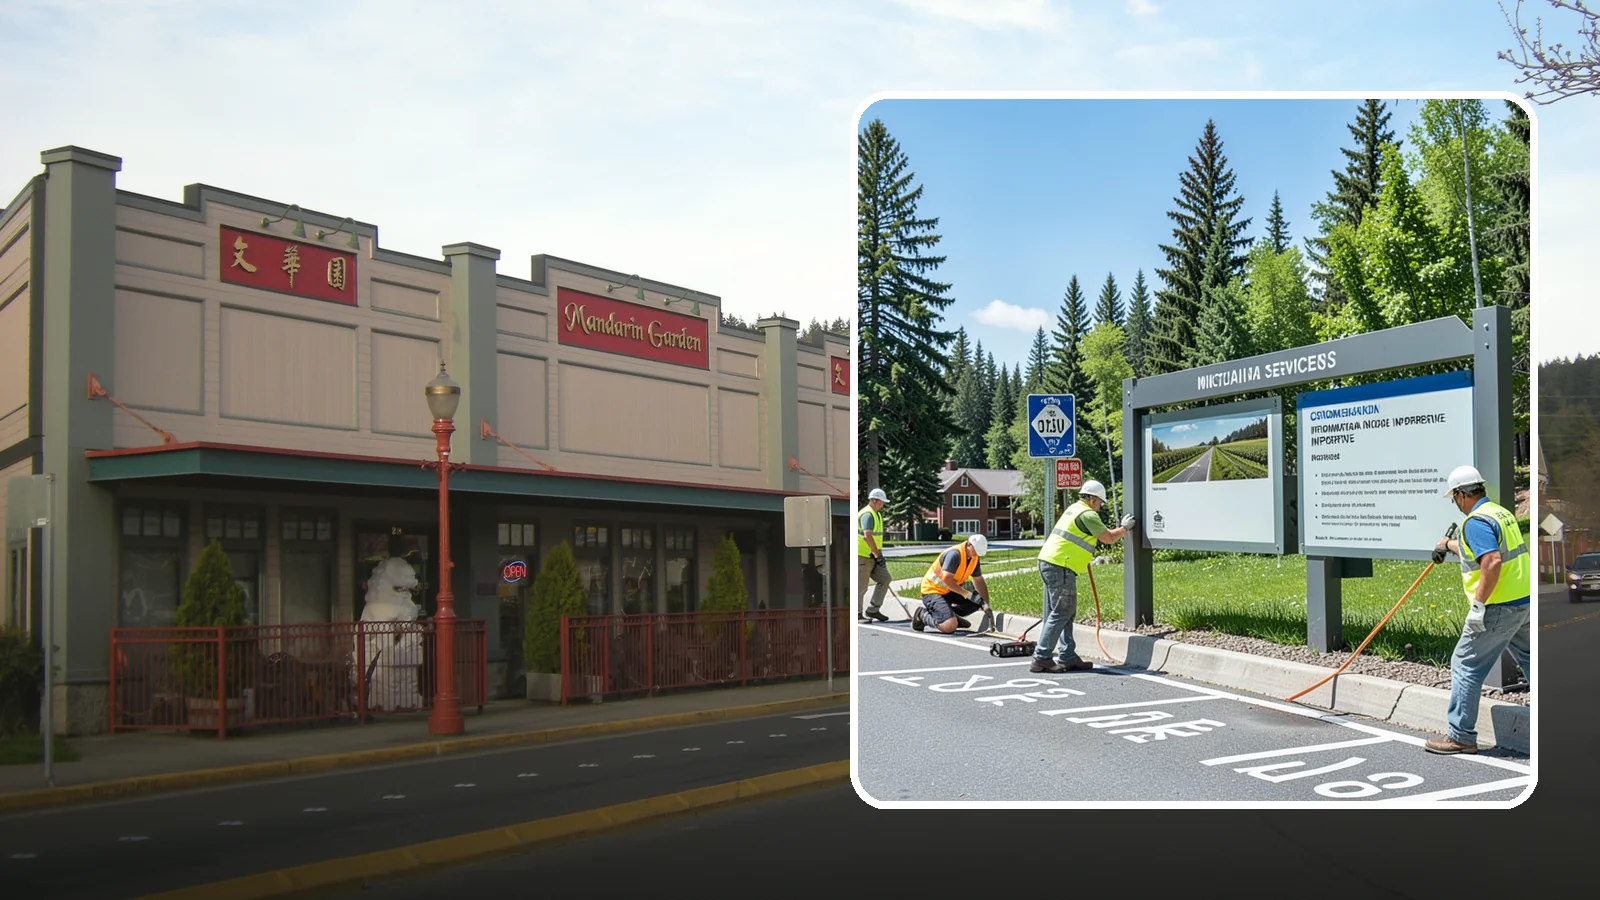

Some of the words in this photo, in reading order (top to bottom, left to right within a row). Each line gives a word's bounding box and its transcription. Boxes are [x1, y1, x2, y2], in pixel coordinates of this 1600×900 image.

[231, 235, 346, 291] 文華園
[564, 302, 643, 341] Mandarin
[648, 320, 701, 352] Garden
[503, 565, 527, 578] OPEN
